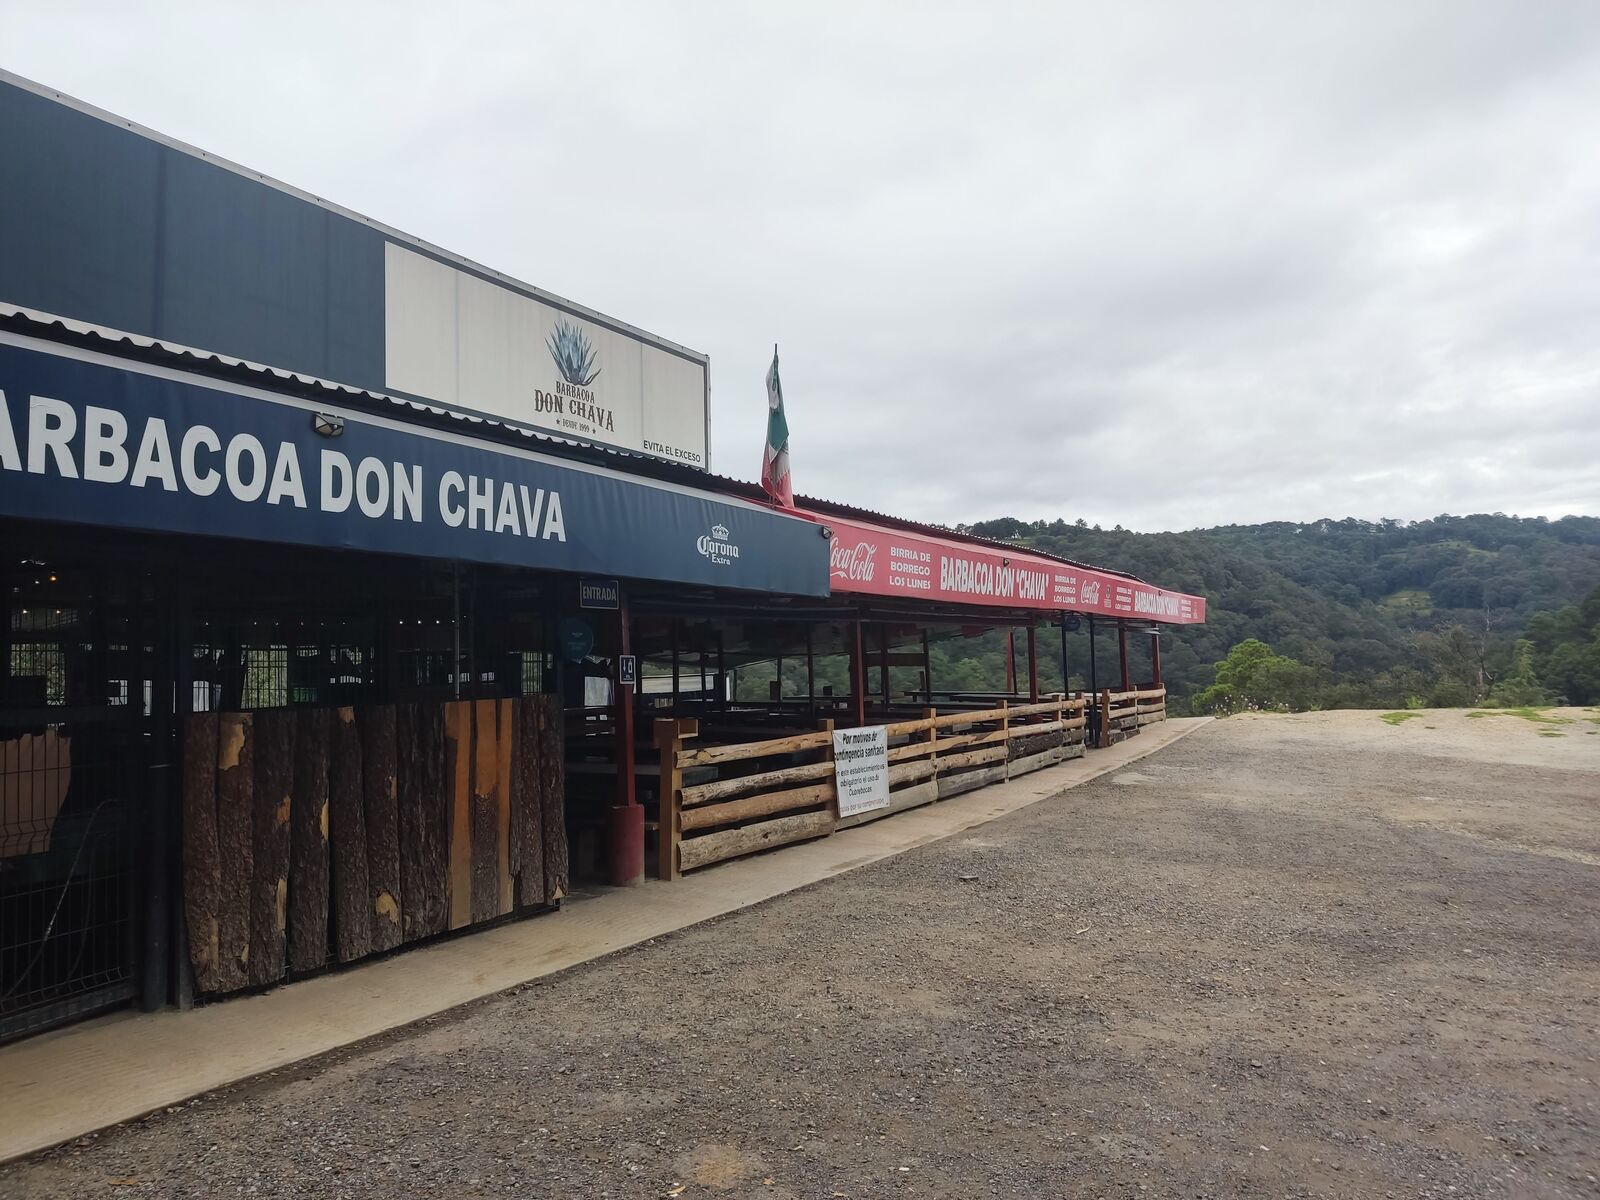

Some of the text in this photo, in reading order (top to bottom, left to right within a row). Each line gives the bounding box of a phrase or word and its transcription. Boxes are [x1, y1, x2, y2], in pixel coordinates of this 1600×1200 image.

[556, 380, 595, 404] BARBACOA
[534, 389, 615, 432] DON CHAVA
[562, 418, 590, 433] DESDE 1999
[643, 440, 701, 463] EVITA EL EXCESO
[320, 449, 423, 523] DON
[439, 470, 567, 543] CHAVA
[696, 535, 739, 558] Corona
[890, 546, 931, 563] BIRRIA DE
[711, 554, 731, 566] Extra
[890, 562, 930, 576] BORREGO
[940, 556, 994, 596] BARBACOA
[995, 564, 1015, 598] DON
[889, 575, 931, 590] LOS LUNES
[582, 585, 617, 602] ENTRADA
[1053, 595, 1062, 603] LOS
[842, 731, 878, 745] Por motivos de
